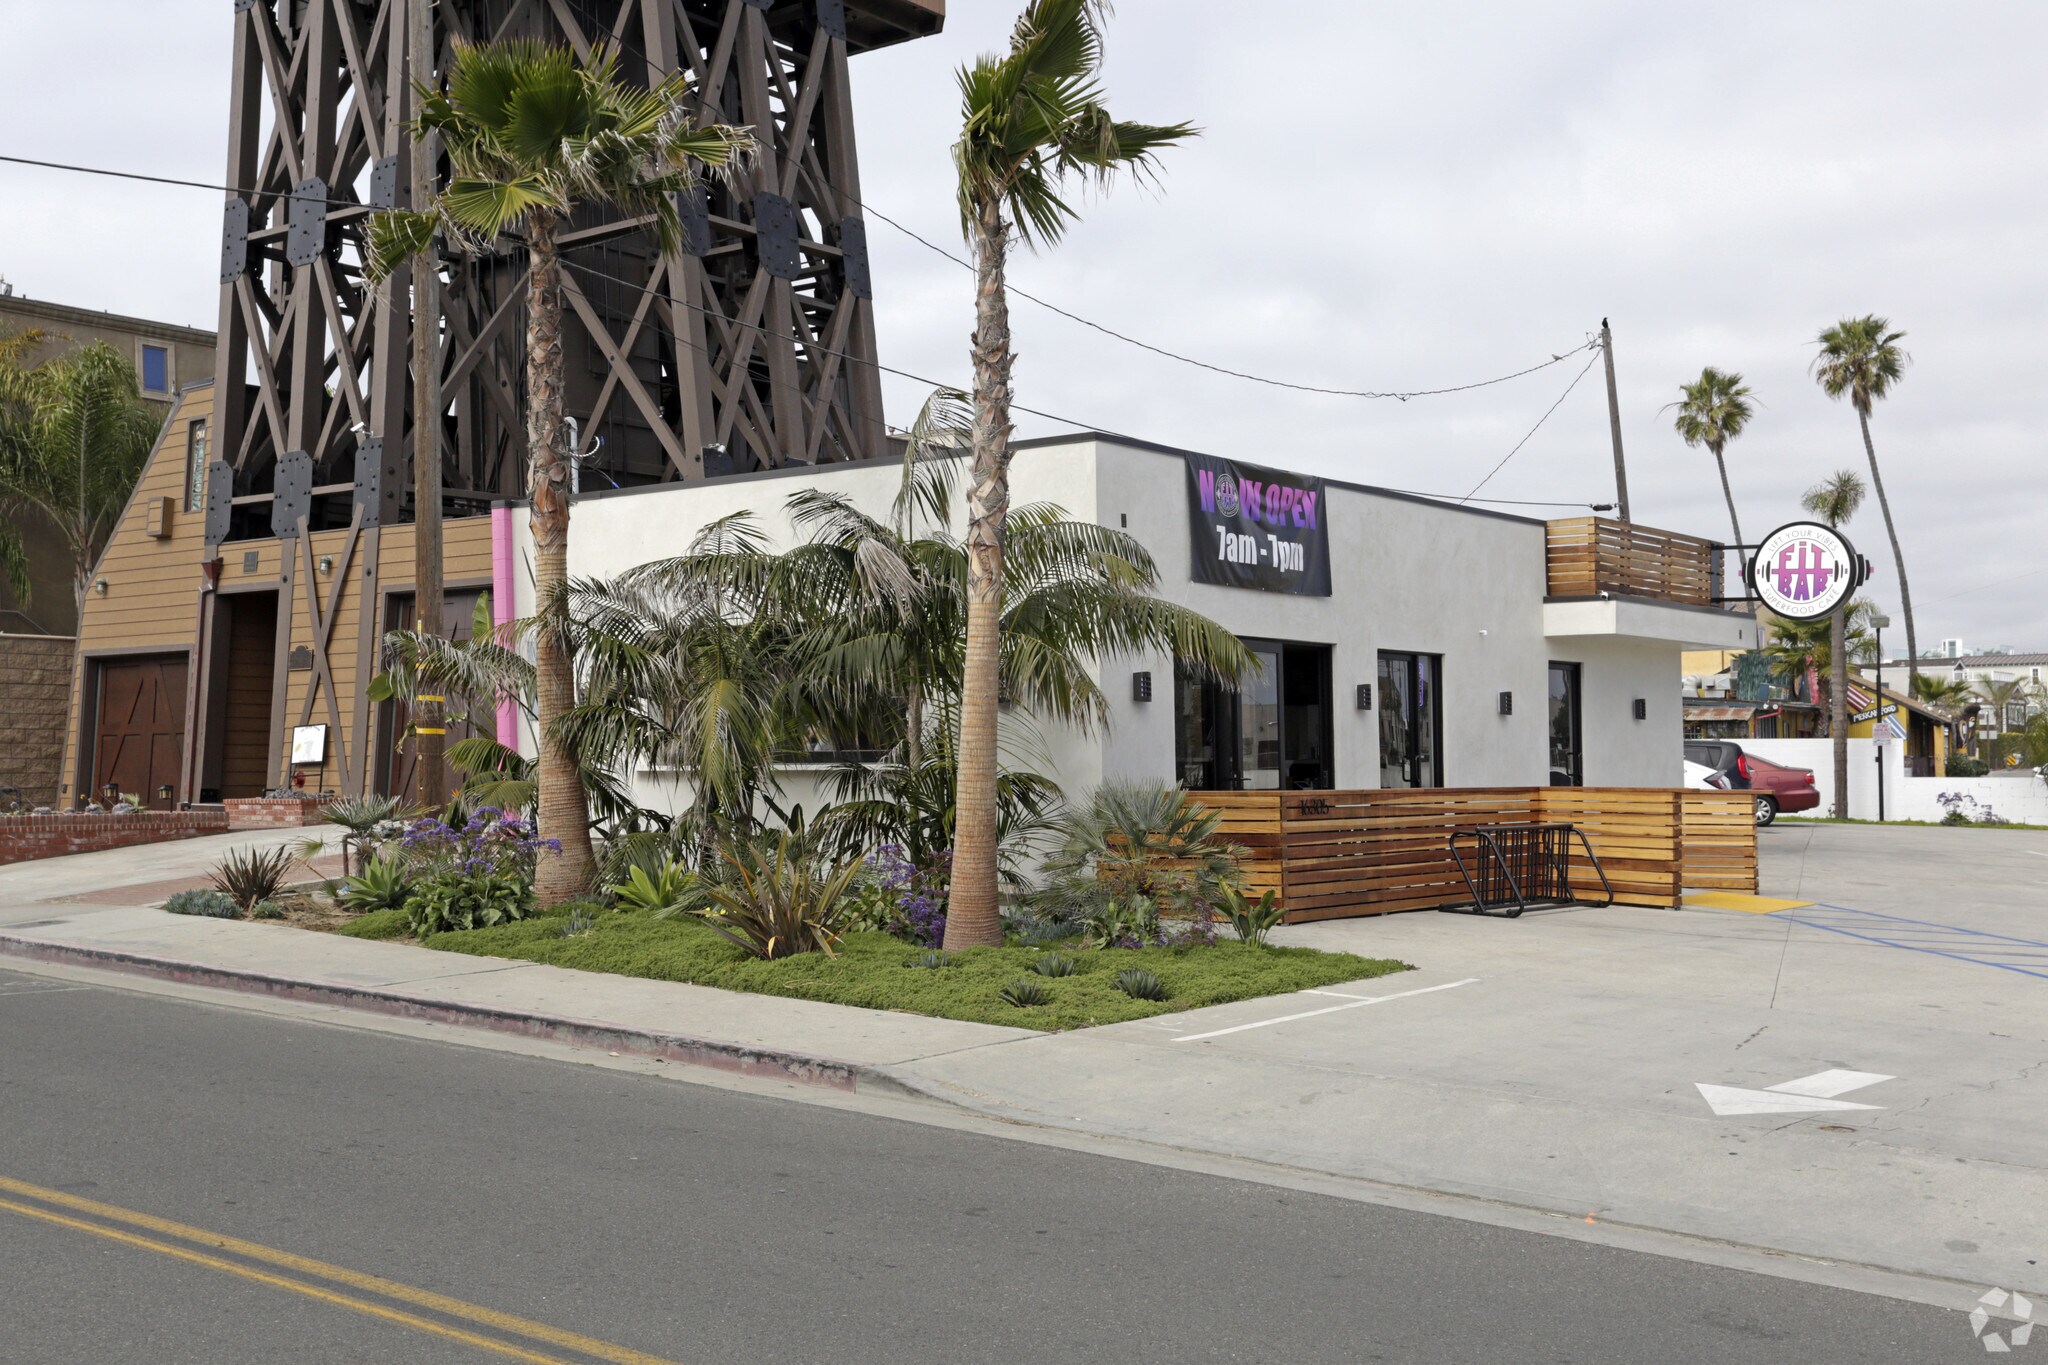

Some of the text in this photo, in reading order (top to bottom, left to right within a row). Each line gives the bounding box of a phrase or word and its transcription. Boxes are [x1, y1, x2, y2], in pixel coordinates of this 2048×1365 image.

[1198, 469, 1317, 530] NOW OPEN
[1216, 524, 1257, 565] 7am
[1267, 533, 1304, 573] 7pm
[1768, 529, 1839, 553] LIFT YOUR VIBES
[1762, 588, 1840, 614] SUPERFOOD CAFE
[1778, 572, 1828, 601] BAR
